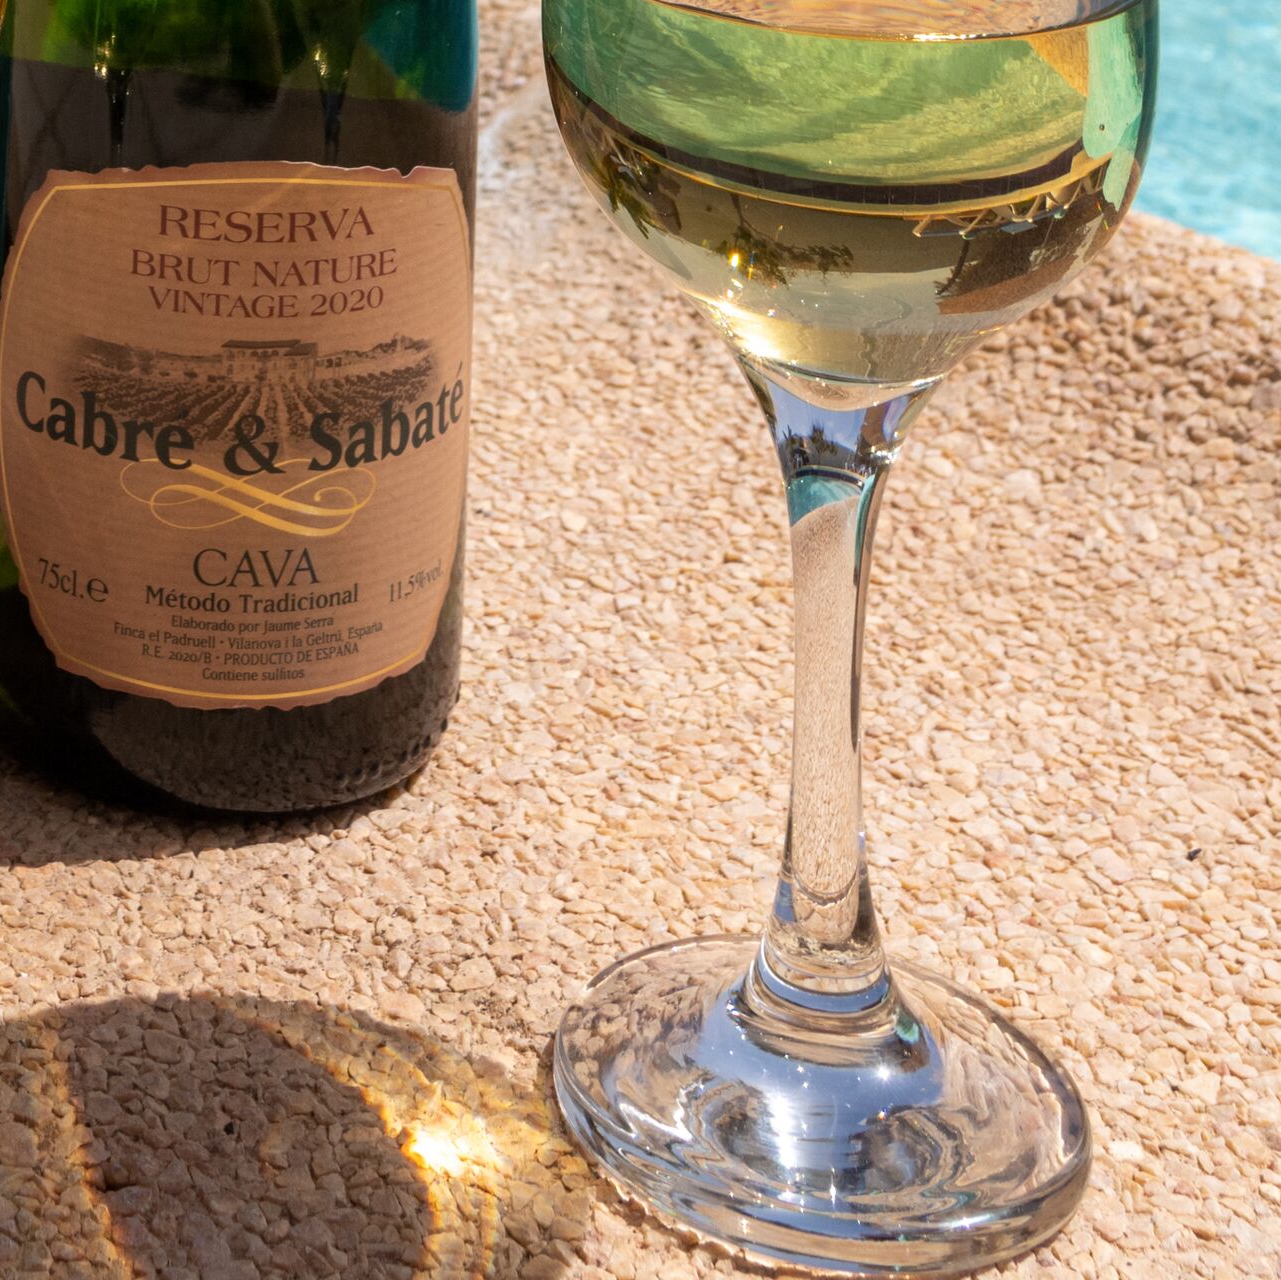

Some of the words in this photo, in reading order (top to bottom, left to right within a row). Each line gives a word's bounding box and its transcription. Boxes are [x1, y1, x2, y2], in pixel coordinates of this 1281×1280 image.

[158, 204, 375, 243] RESERVA
[131, 249, 240, 286] BRUT
[252, 248, 398, 287] NATURE
[148, 286, 299, 319] VINTAGE
[310, 286, 384, 317] 2020
[223, 414, 286, 476] &
[308, 361, 464, 472] Sabaté
[193, 547, 320, 588] CAVA
[145, 585, 230, 613] Método
[239, 583, 359, 613] Tradicional
[113, 622, 145, 640] Finca
[148, 630, 160, 642] el
[163, 632, 215, 649] Padruell
[228, 637, 281, 650] Vilanova
[292, 636, 303, 648] la
[171, 615, 235, 632] Elaborado
[238, 622, 259, 635] por
[262, 620, 300, 635] Jaume
[304, 616, 334, 630] Serra
[168, 650, 212, 664] 2020/B
[223, 652, 293, 666] PRODUCTO
[297, 650, 312, 662] DE
[315, 641, 359, 661] ESPAÑA
[202, 667, 258, 681] Contiene
[261, 667, 305, 681] sulfitos
